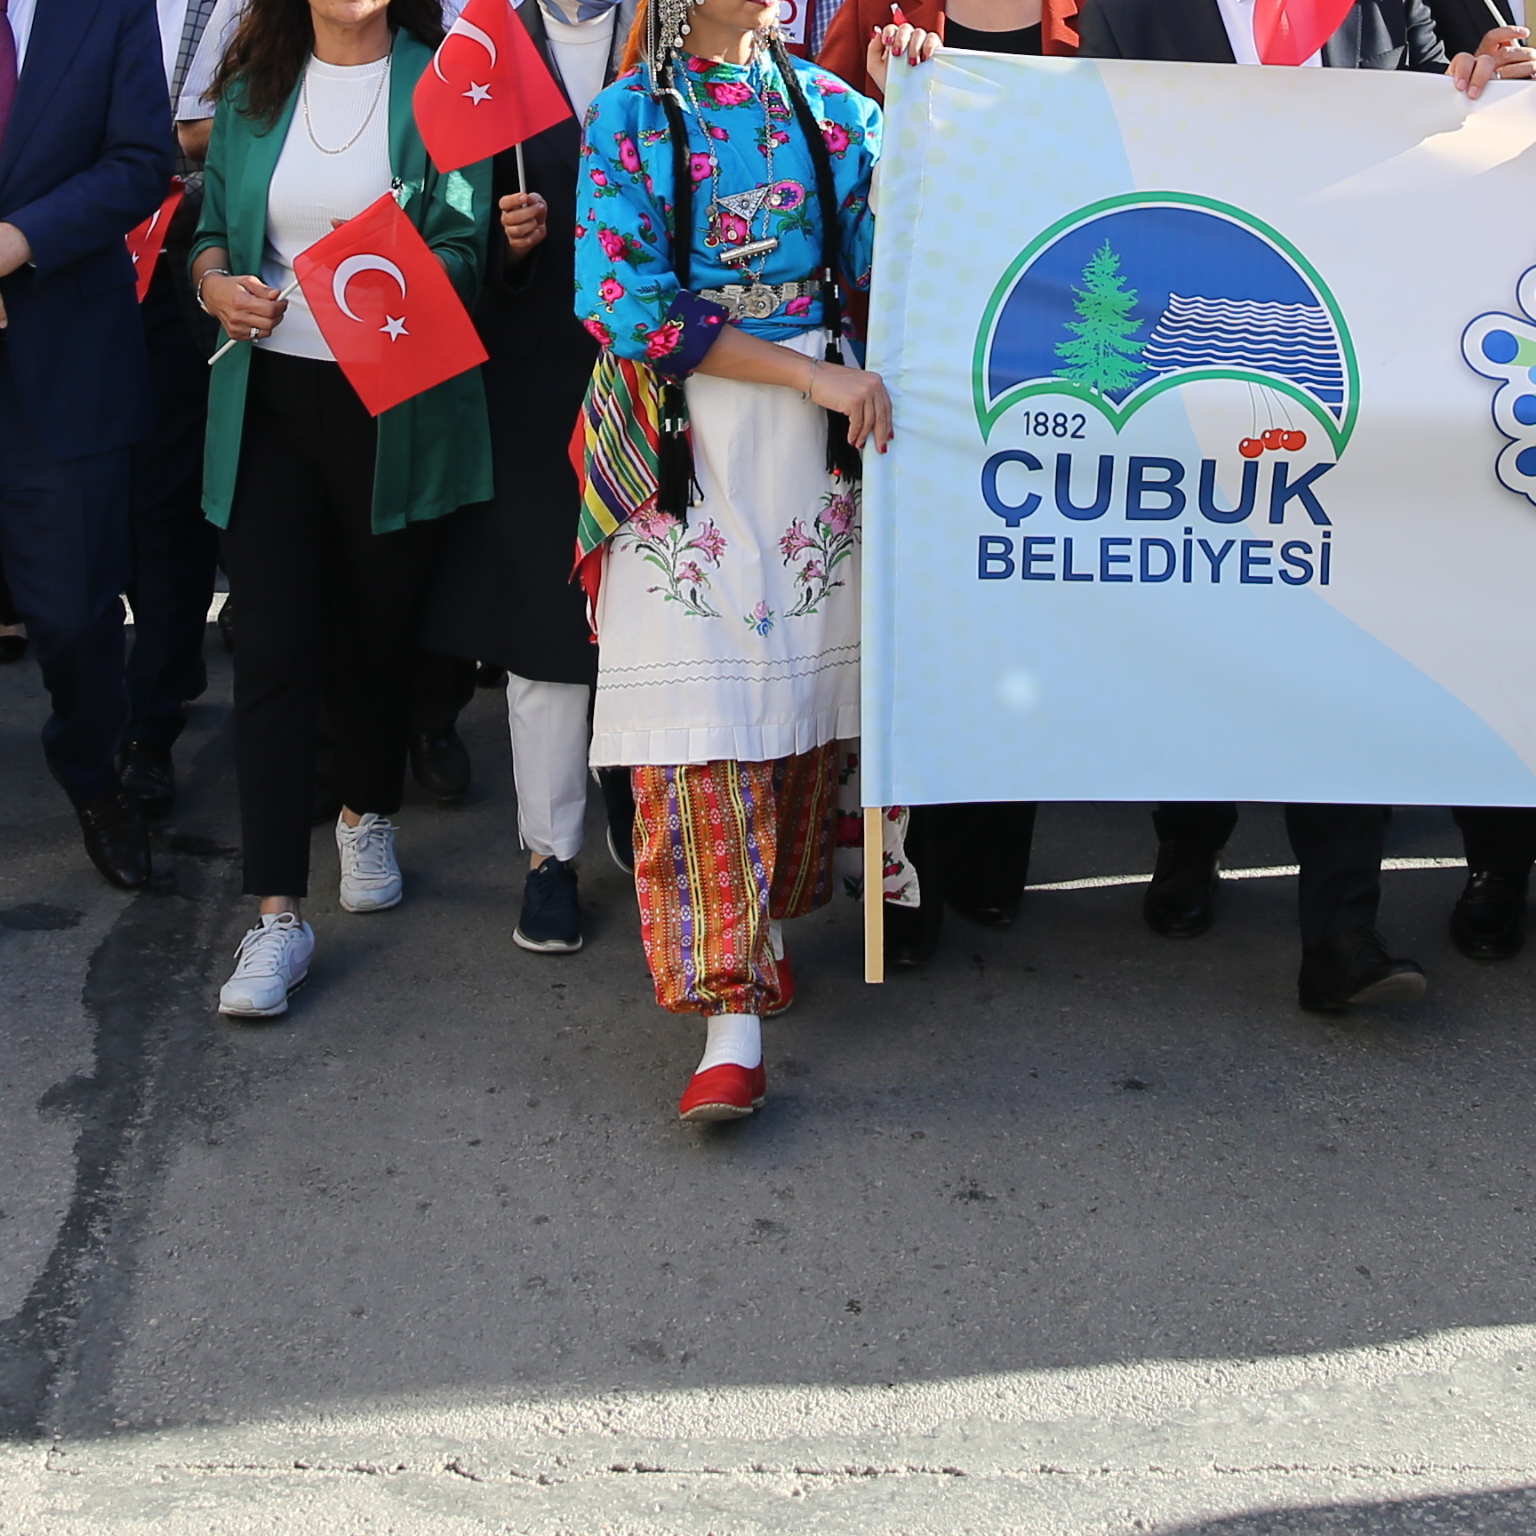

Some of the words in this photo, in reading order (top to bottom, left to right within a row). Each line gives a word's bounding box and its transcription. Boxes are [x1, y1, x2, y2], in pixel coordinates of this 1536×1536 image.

[1023, 411, 1086, 439] 1882
[980, 449, 1338, 528] ÇUBUK
[977, 526, 1332, 586] BELEDİYESİ
